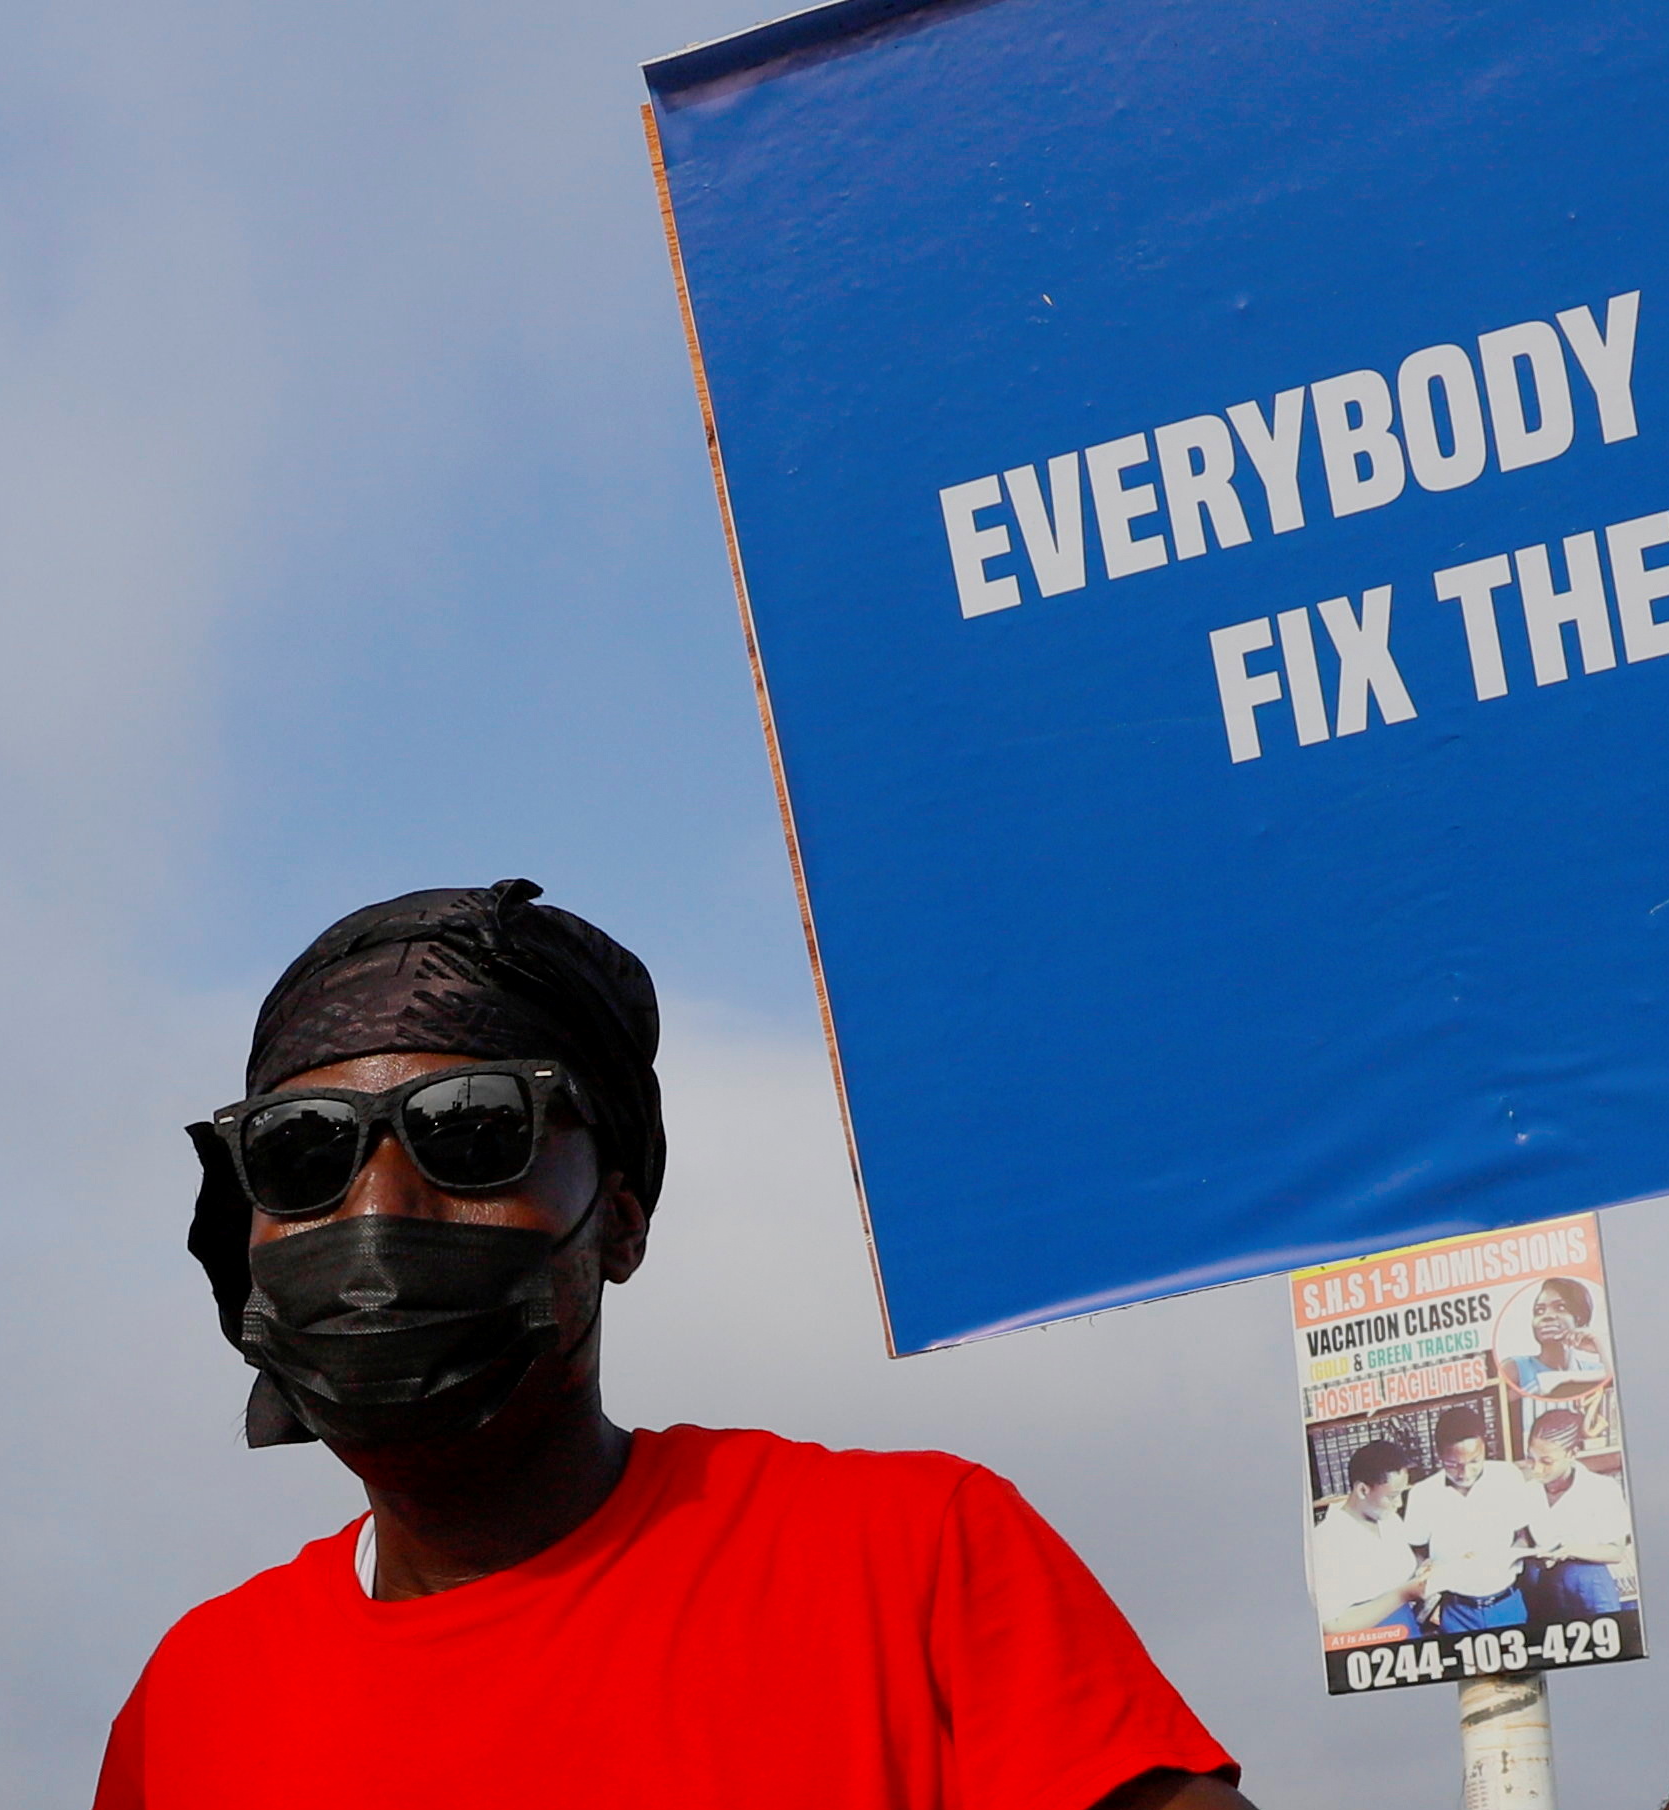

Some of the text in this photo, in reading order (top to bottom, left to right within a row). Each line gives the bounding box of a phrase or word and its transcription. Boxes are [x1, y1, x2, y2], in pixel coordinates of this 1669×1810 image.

[939, 290, 1641, 619] EVERYBODY
[1209, 584, 1418, 764] FIX
[1303, 1226, 1587, 1320] S.H.S 1-3 ADMISSIONS
[1306, 1293, 1492, 1357] VACATION CLASSES
[1353, 1353, 1364, 1372] &
[1367, 1344, 1413, 1370] GREEN
[1418, 1329, 1480, 1360] TRACKS)
[1312, 1358, 1486, 1421] HOSTEL FACILITIES
[1346, 1617, 1622, 1691] 0244-103-429
